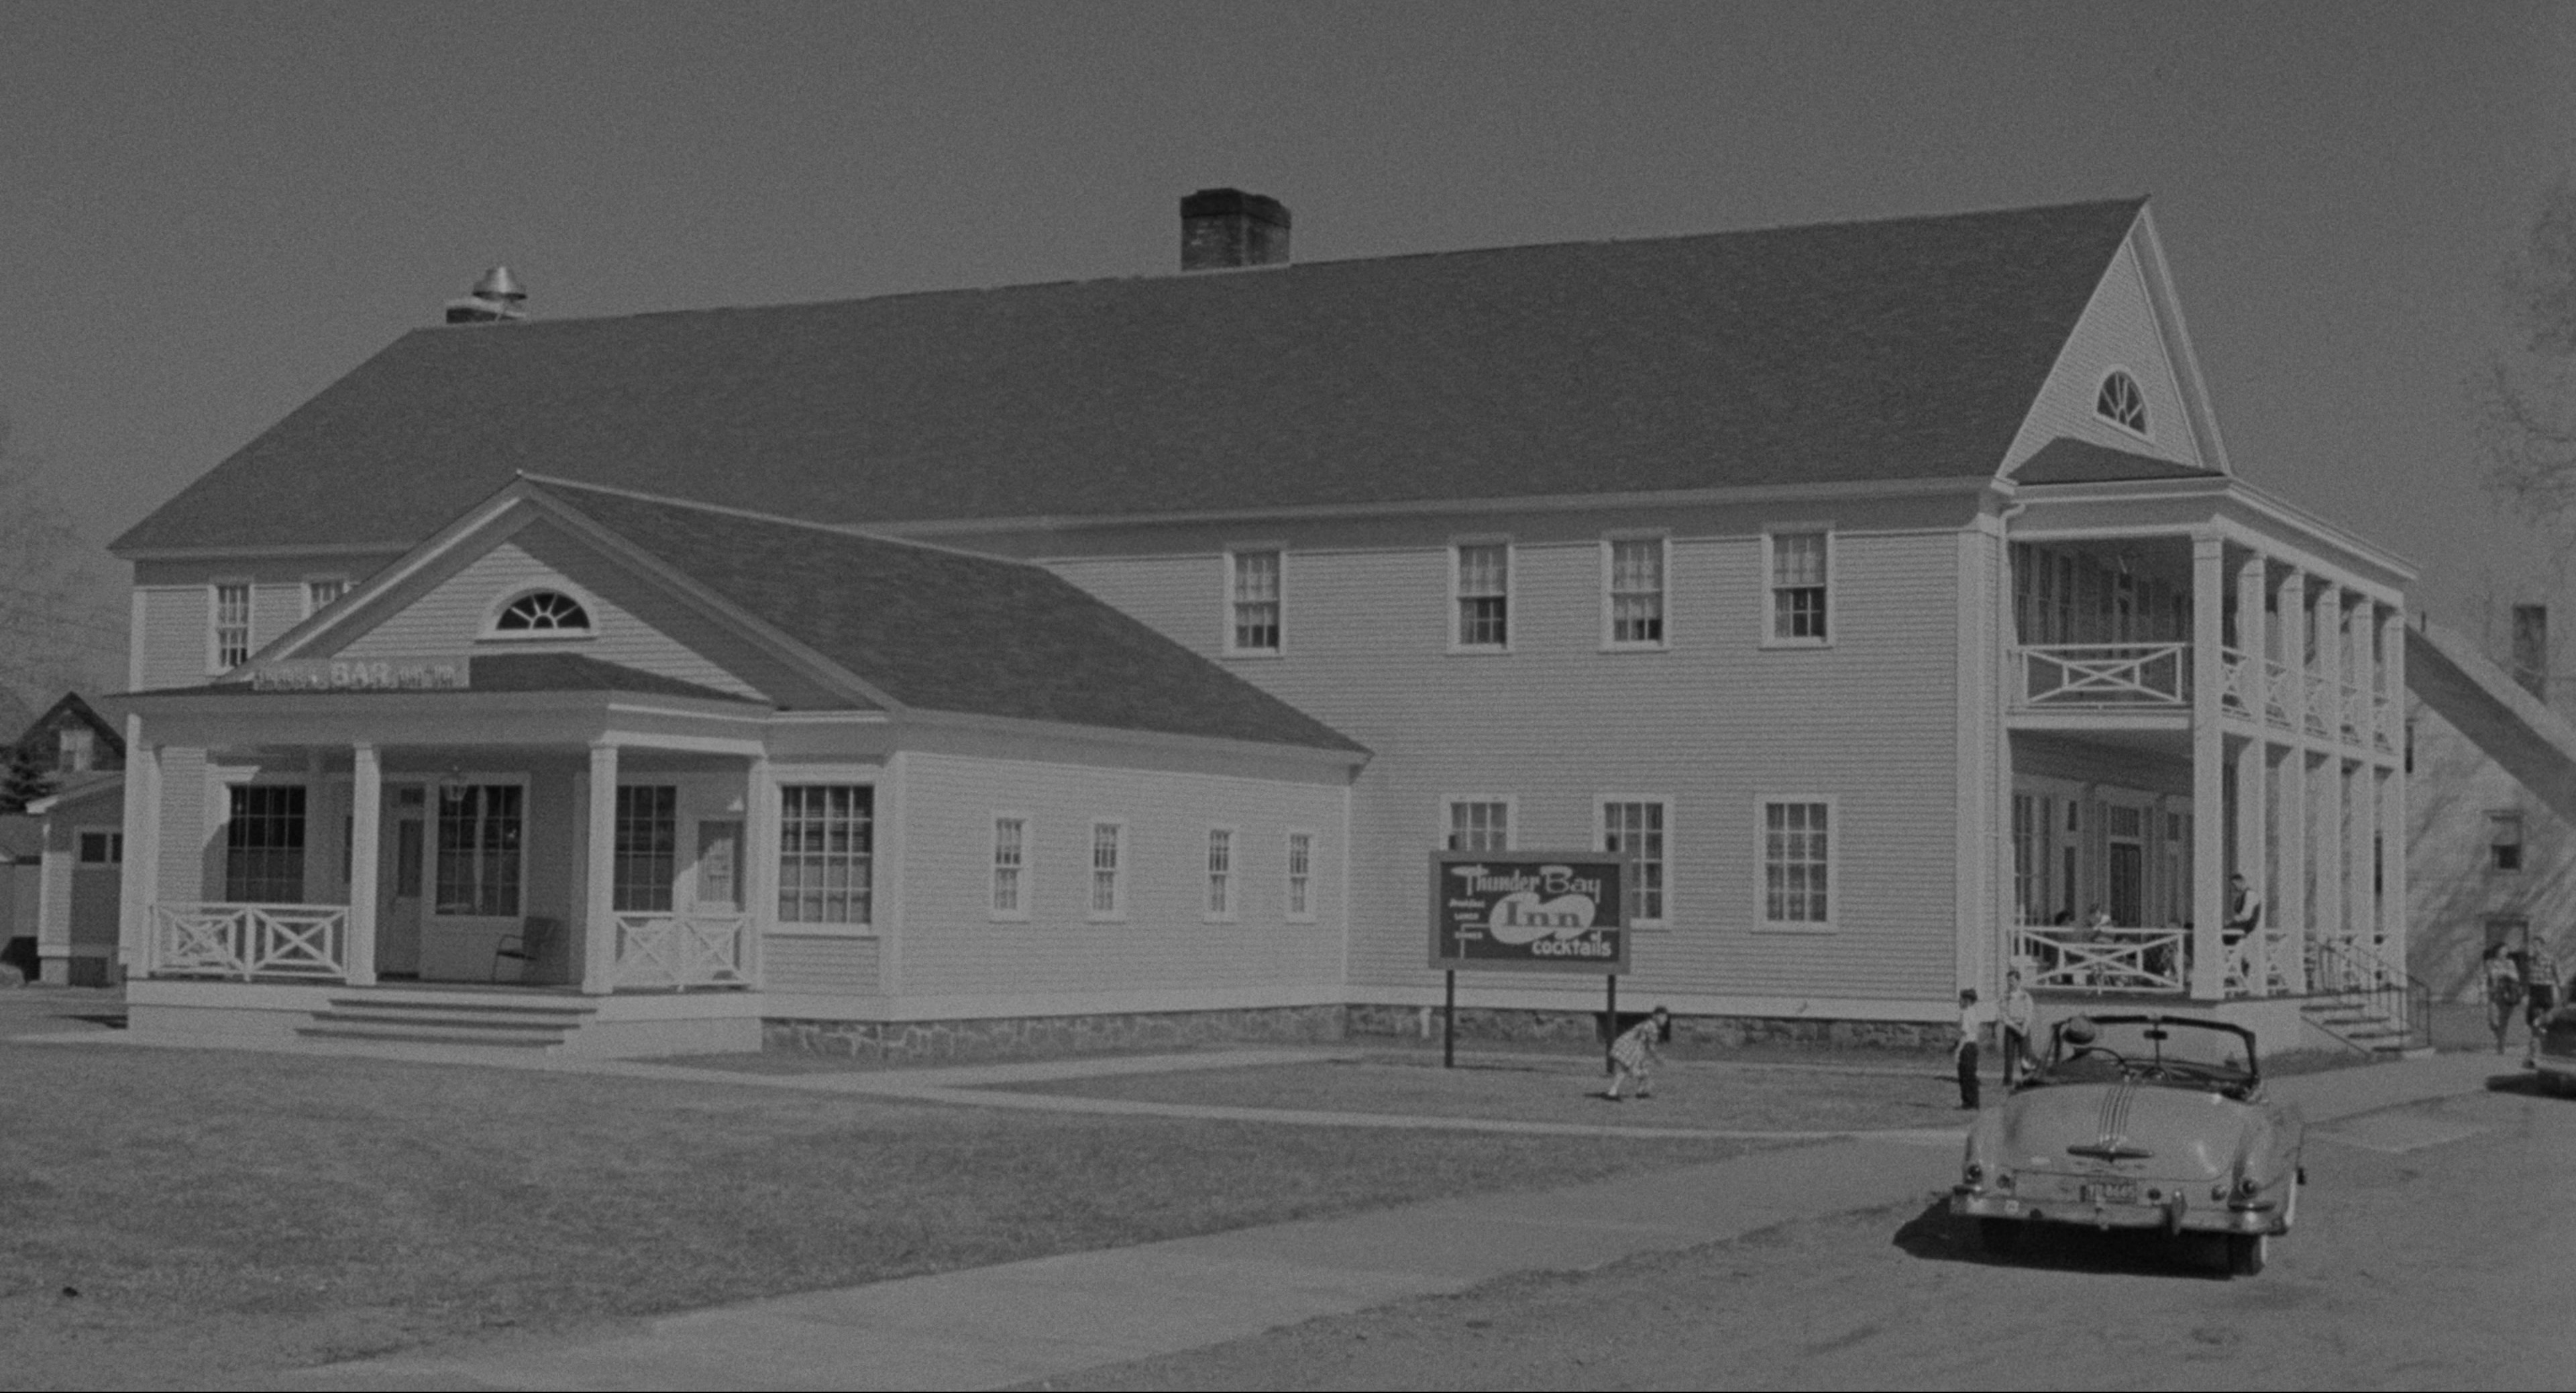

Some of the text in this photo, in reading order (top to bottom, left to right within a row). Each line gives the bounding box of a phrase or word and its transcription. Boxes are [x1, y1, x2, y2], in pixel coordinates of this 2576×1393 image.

[331, 662, 398, 688] BAR
[1451, 865, 1601, 904] Thunder Bay
[1502, 902, 1580, 927] Inn
[1532, 932, 1611, 956] cocktails
